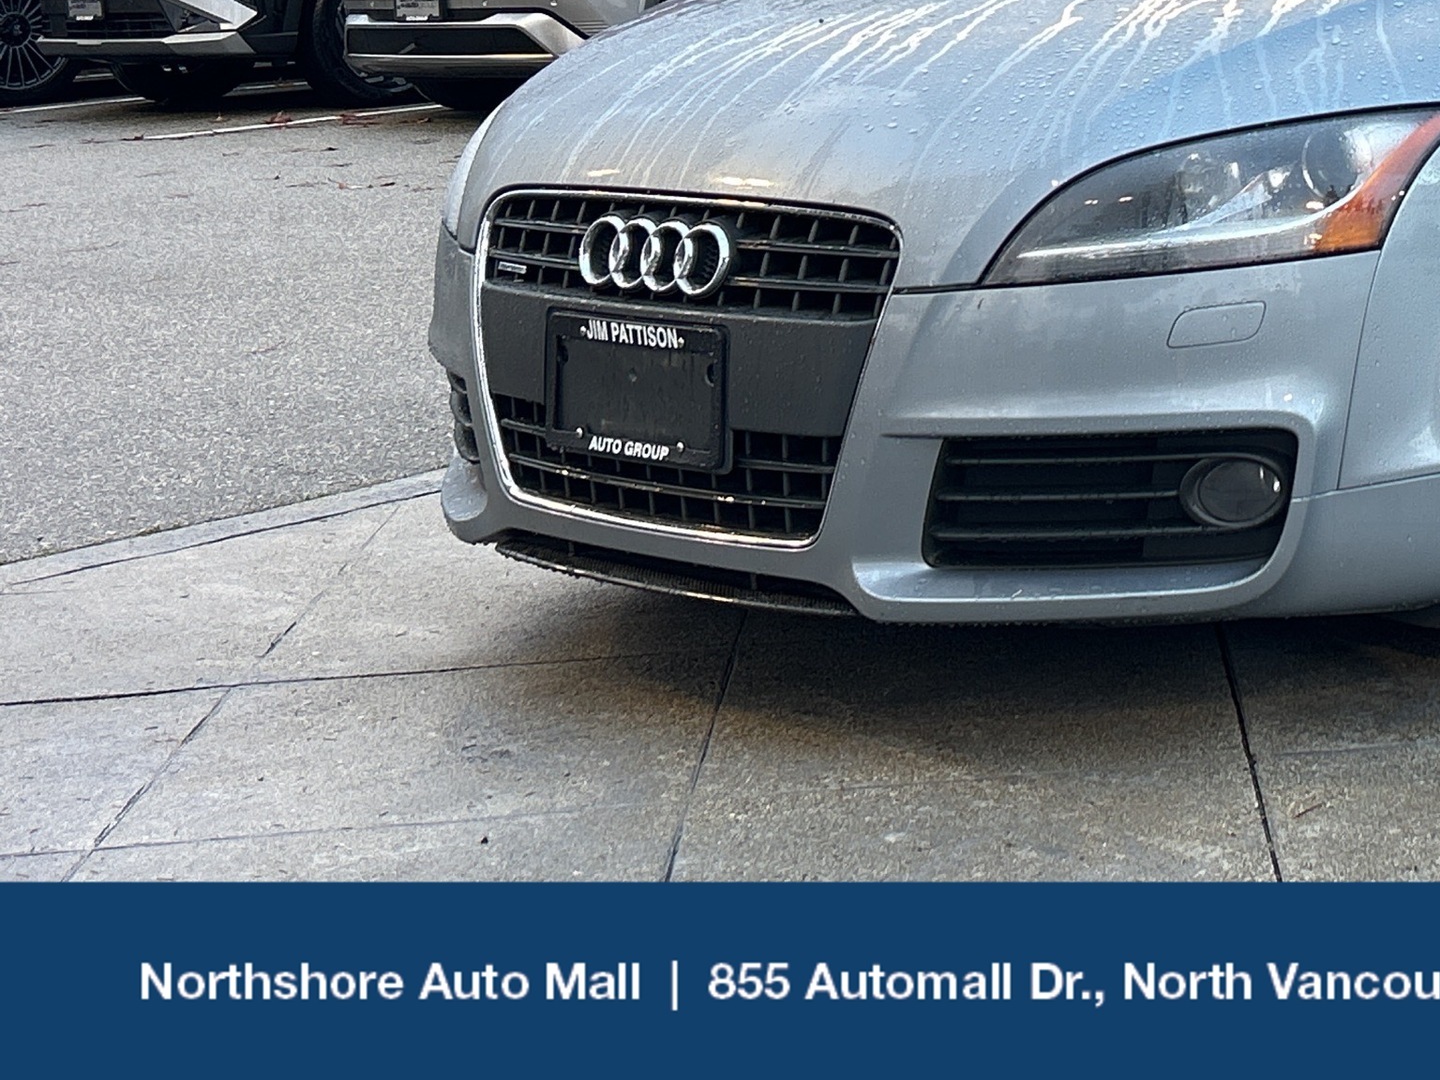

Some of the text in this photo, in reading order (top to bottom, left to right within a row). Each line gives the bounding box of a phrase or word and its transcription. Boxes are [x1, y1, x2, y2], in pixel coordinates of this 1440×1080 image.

[587, 319, 678, 349] JIM PATTISON
[588, 435, 670, 461] AUTO GROUP
